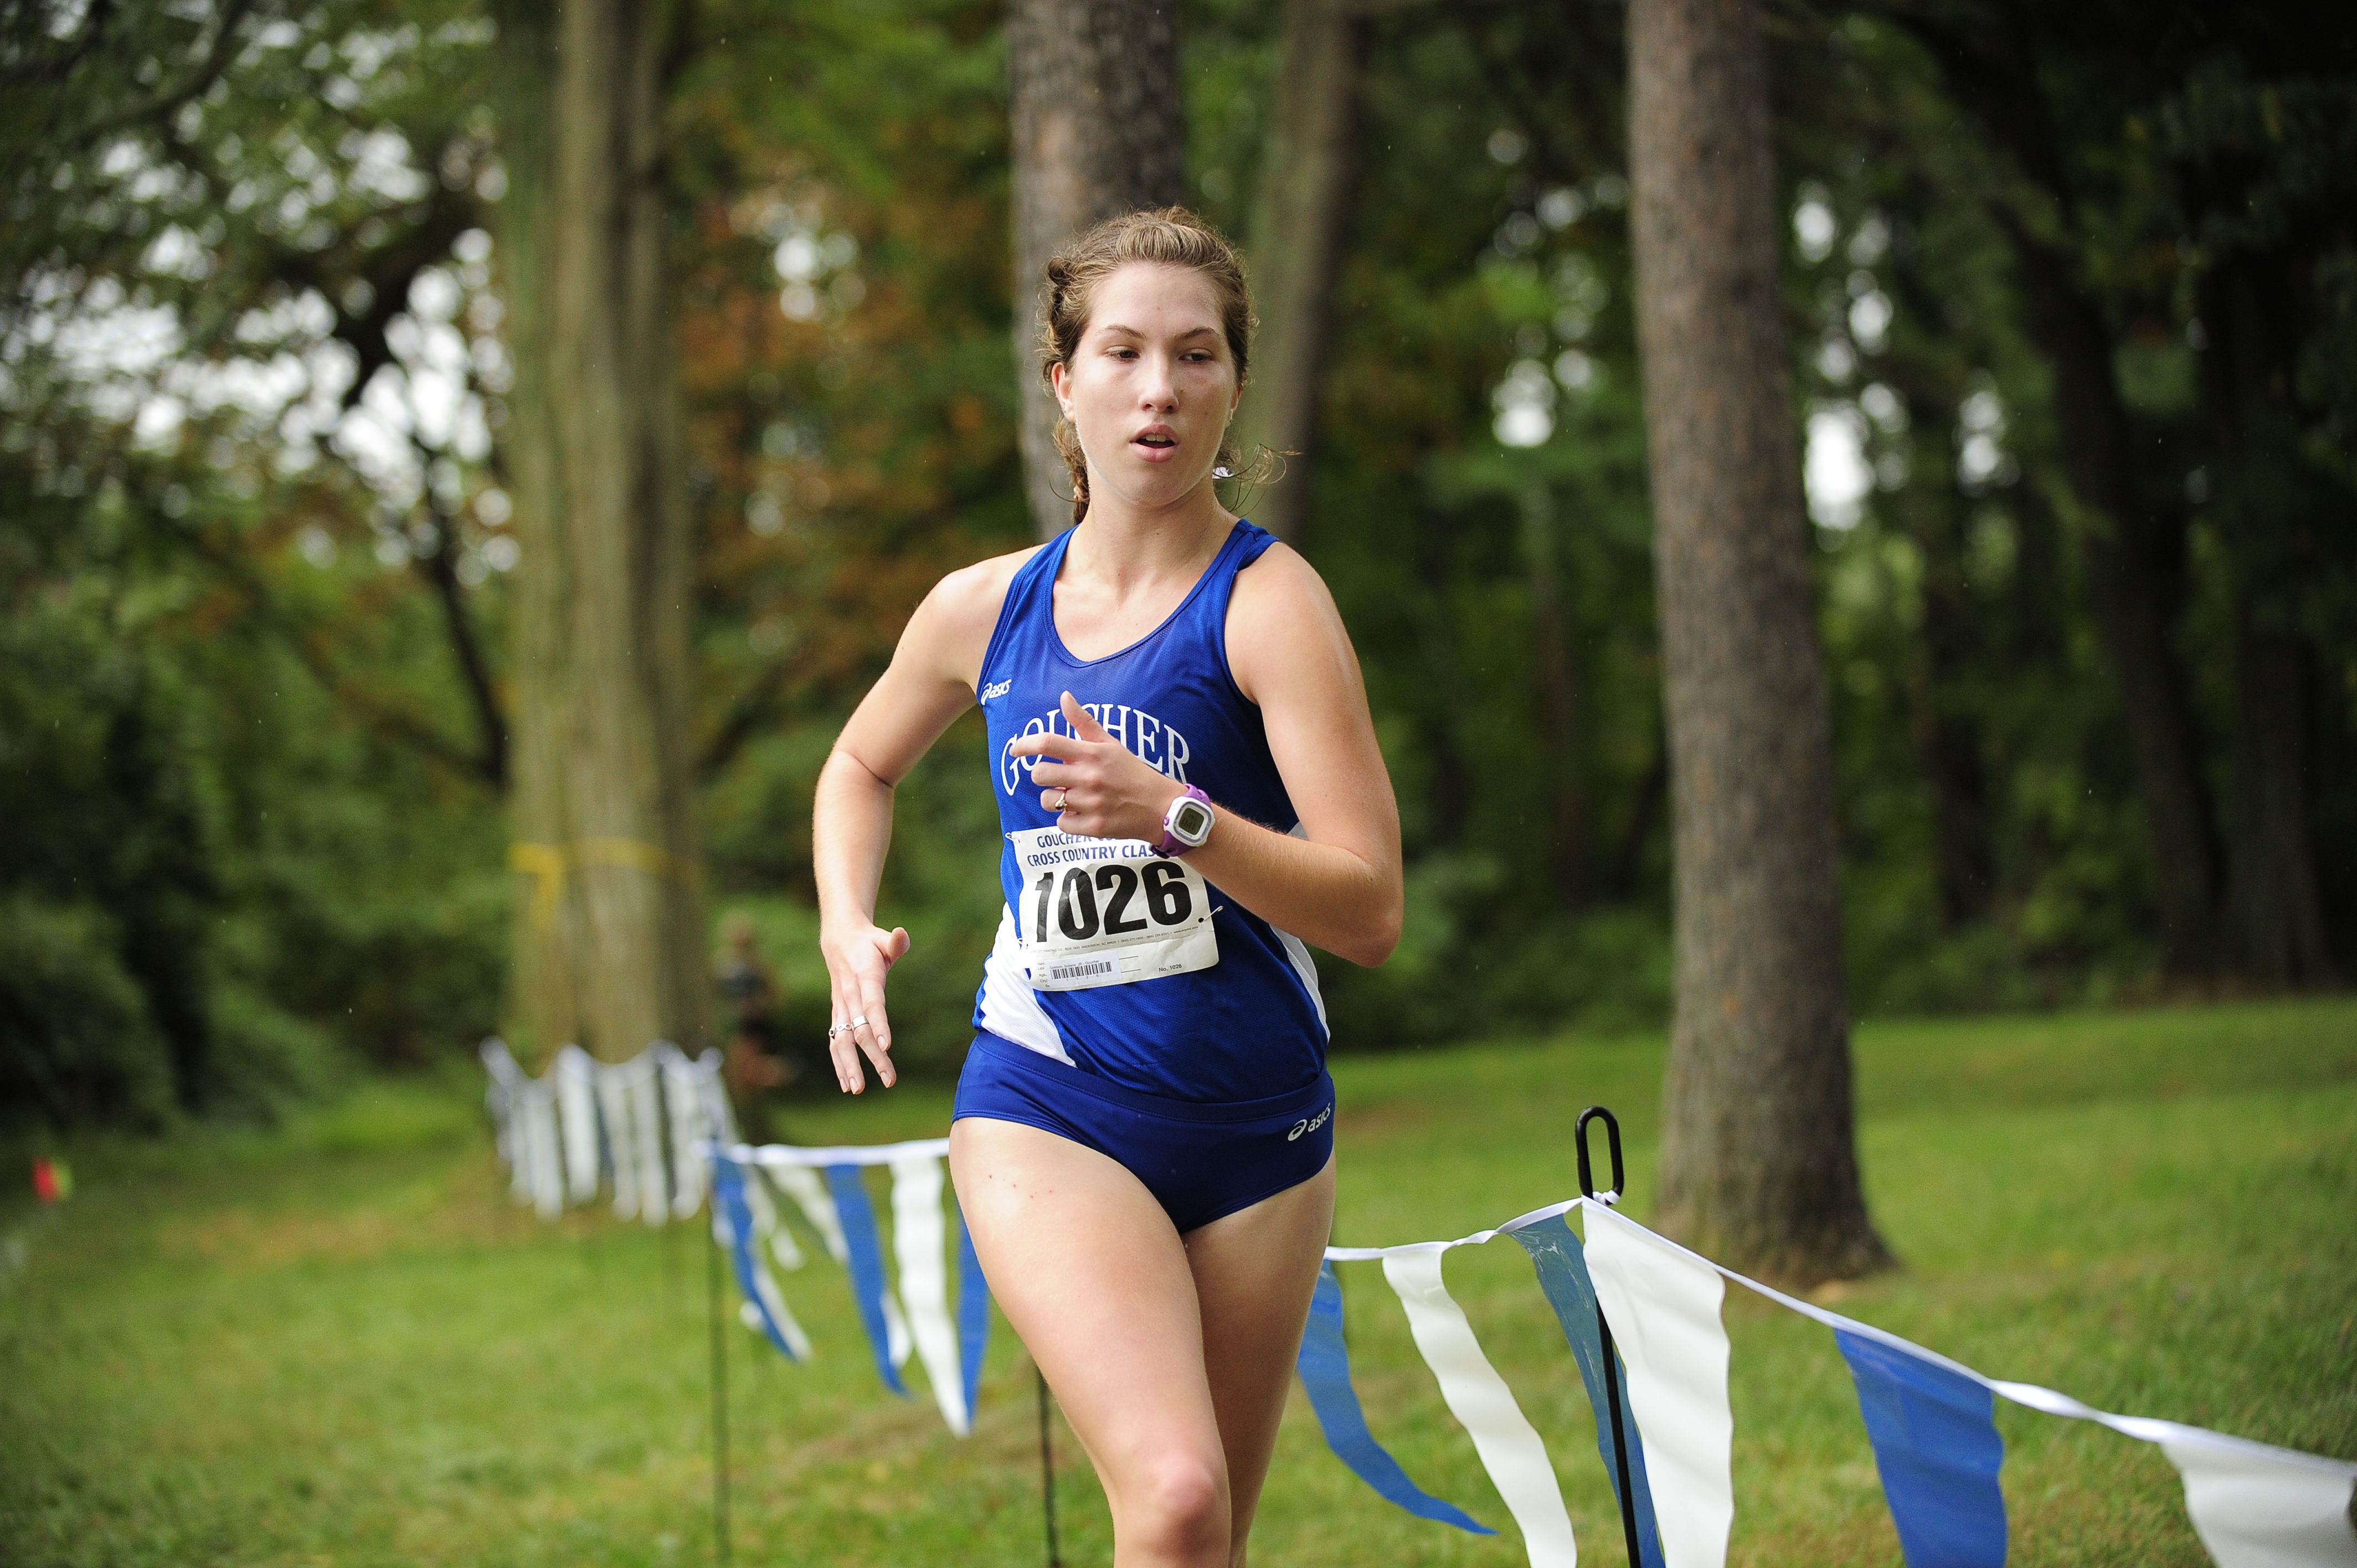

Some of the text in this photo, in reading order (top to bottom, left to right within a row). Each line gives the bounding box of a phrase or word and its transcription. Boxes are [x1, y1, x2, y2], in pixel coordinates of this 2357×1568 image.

[989, 679, 1012, 699] asics
[1037, 833, 1092, 848] GOUCHER
[1027, 851, 1061, 866] CROSS
[1062, 845, 1117, 862] COUNTRY
[1035, 860, 1192, 943] 1026
